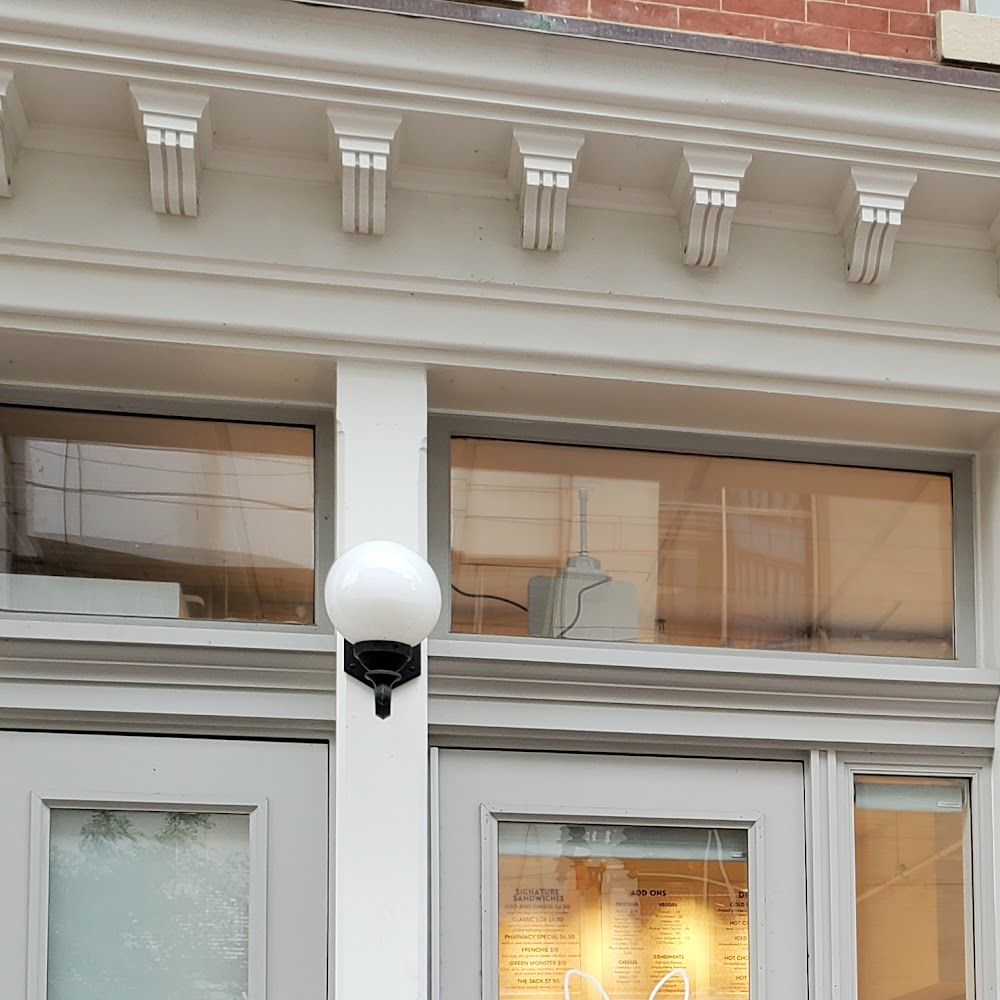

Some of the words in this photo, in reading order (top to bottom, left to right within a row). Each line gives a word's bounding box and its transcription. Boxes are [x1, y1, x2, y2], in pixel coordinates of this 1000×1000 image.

[515, 888, 560, 896] SIGNATURE
[631, 889, 648, 897] ADD
[649, 889, 667, 897] ONS
